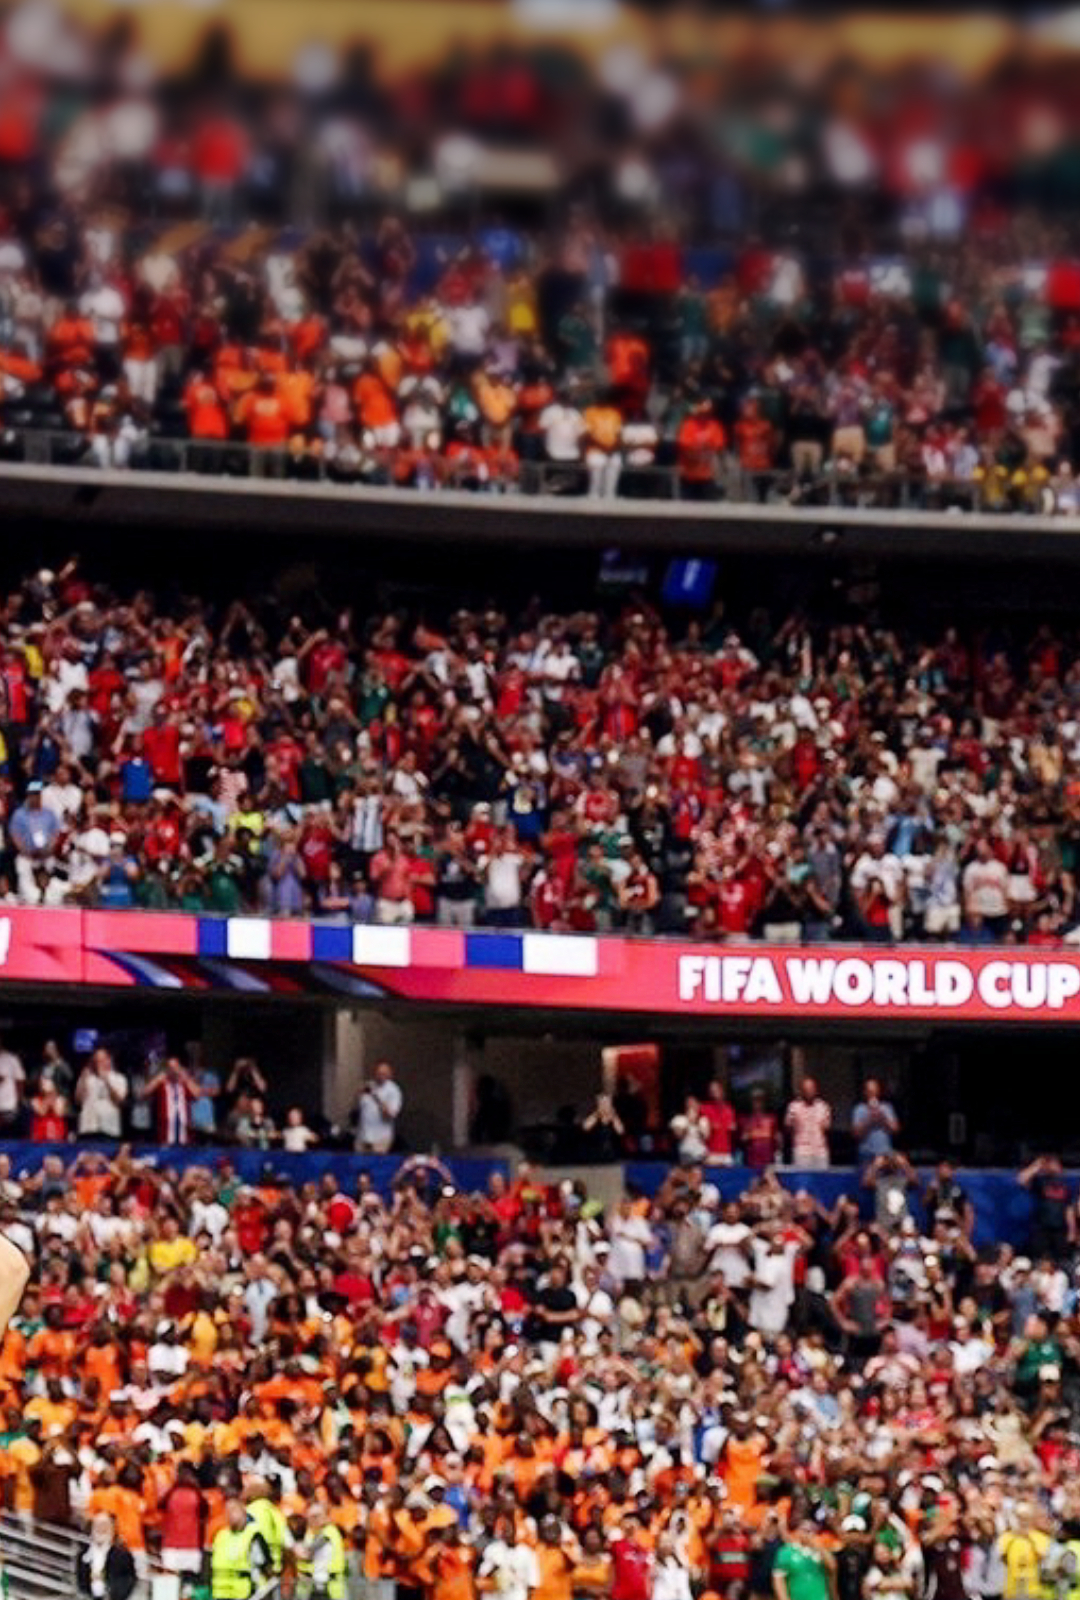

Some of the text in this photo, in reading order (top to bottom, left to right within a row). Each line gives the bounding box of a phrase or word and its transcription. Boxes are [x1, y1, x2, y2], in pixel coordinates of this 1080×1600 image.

[678, 955, 1080, 1009] FIFA WORLD CUP
